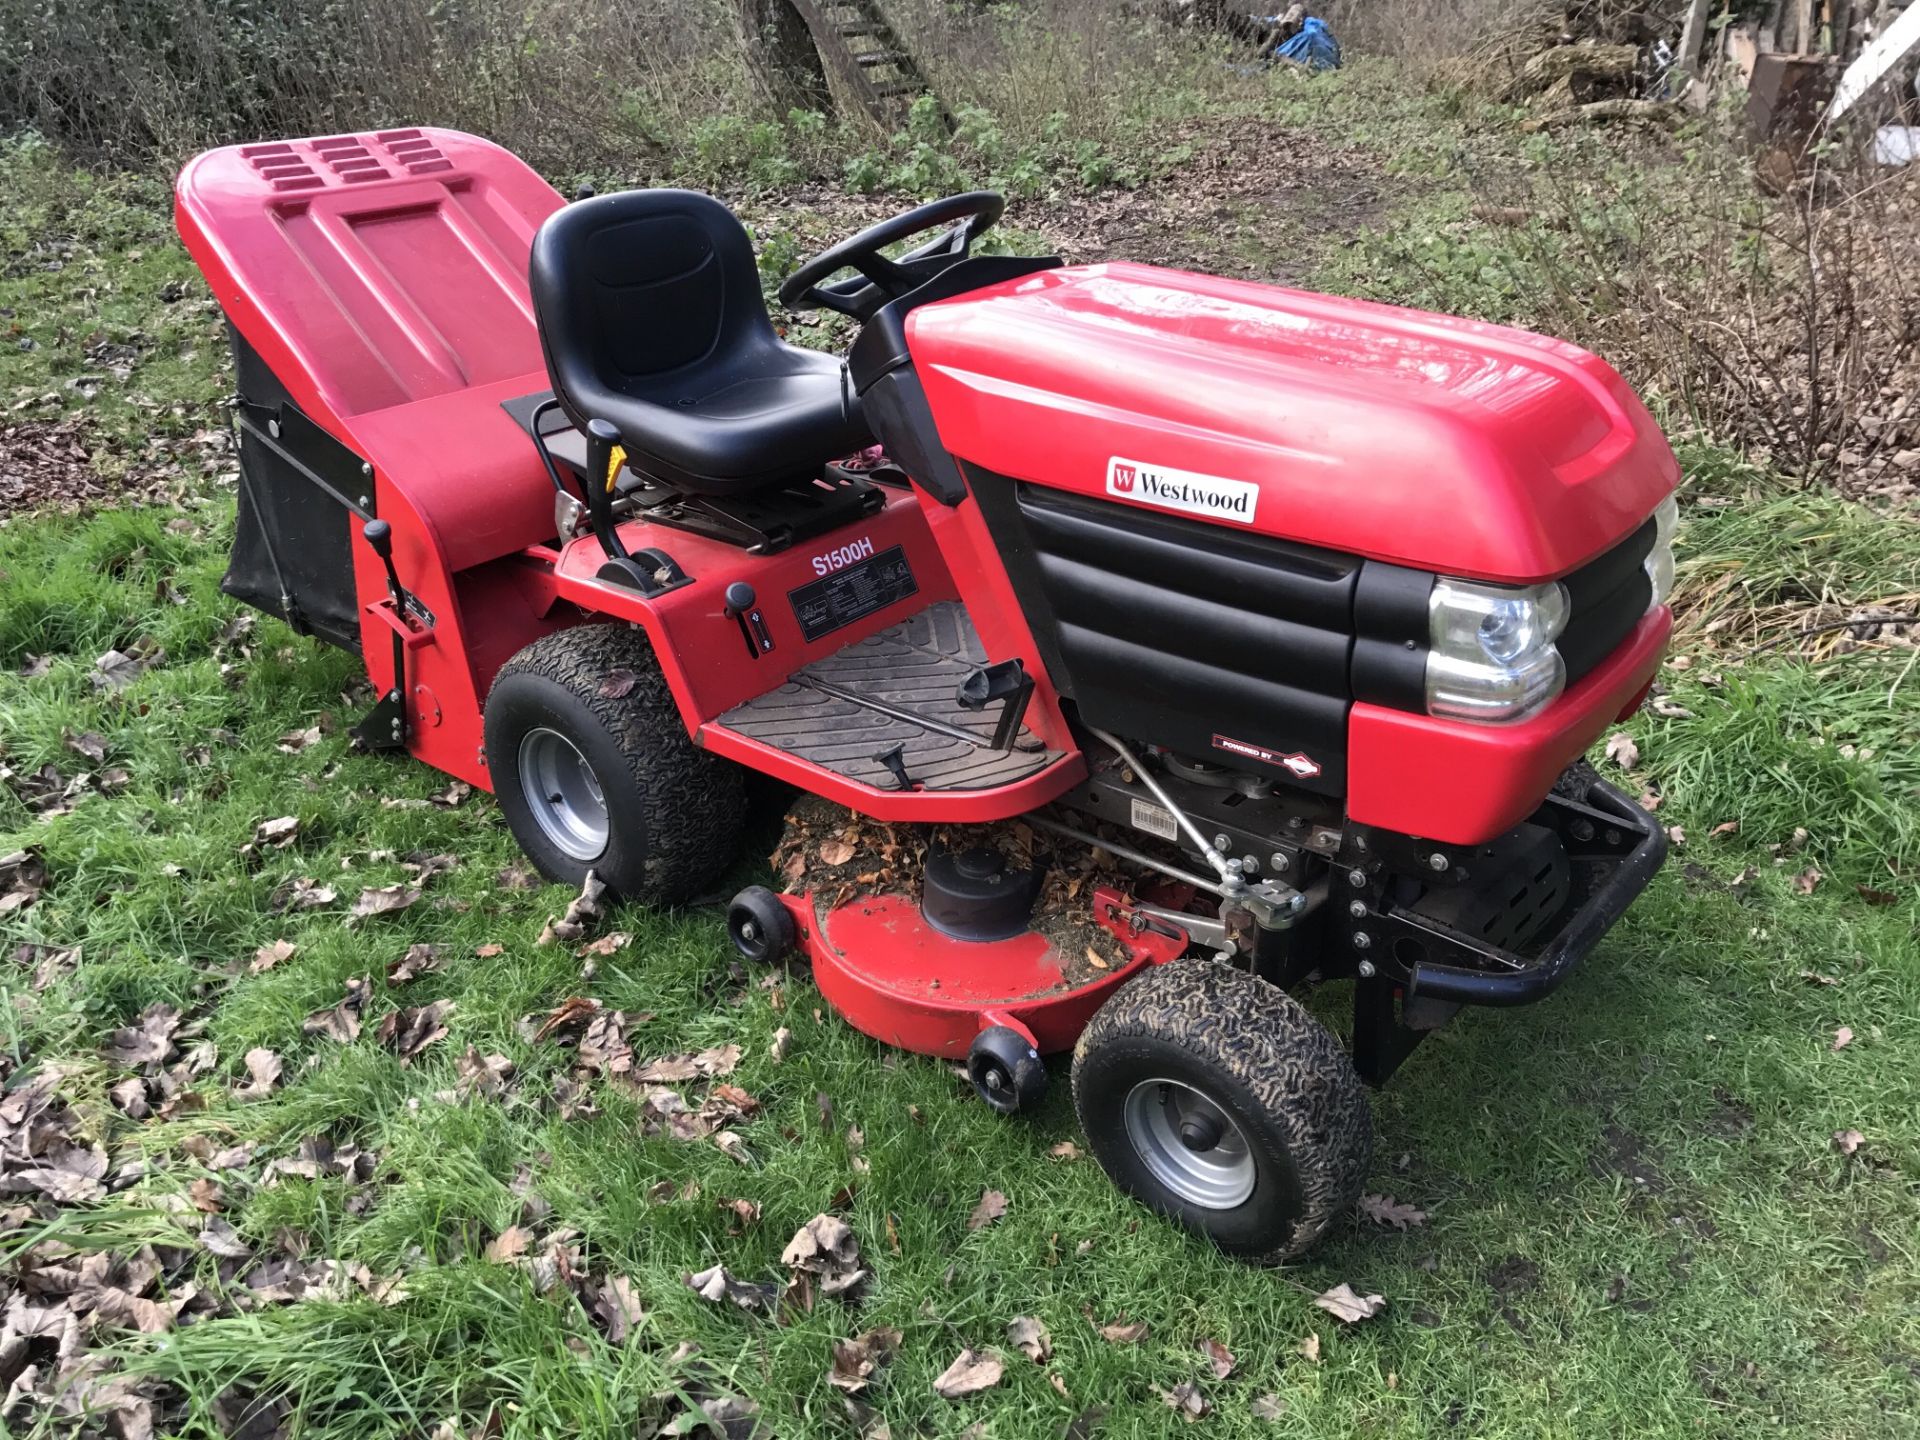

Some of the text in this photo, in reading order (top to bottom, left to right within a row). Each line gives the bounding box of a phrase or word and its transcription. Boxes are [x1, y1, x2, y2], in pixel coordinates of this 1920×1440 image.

[1115, 468, 1135, 487] W
[1141, 472, 1248, 513] Westwood
[812, 537, 874, 575] S1500H
[1222, 740, 1272, 760] POWERED BY
